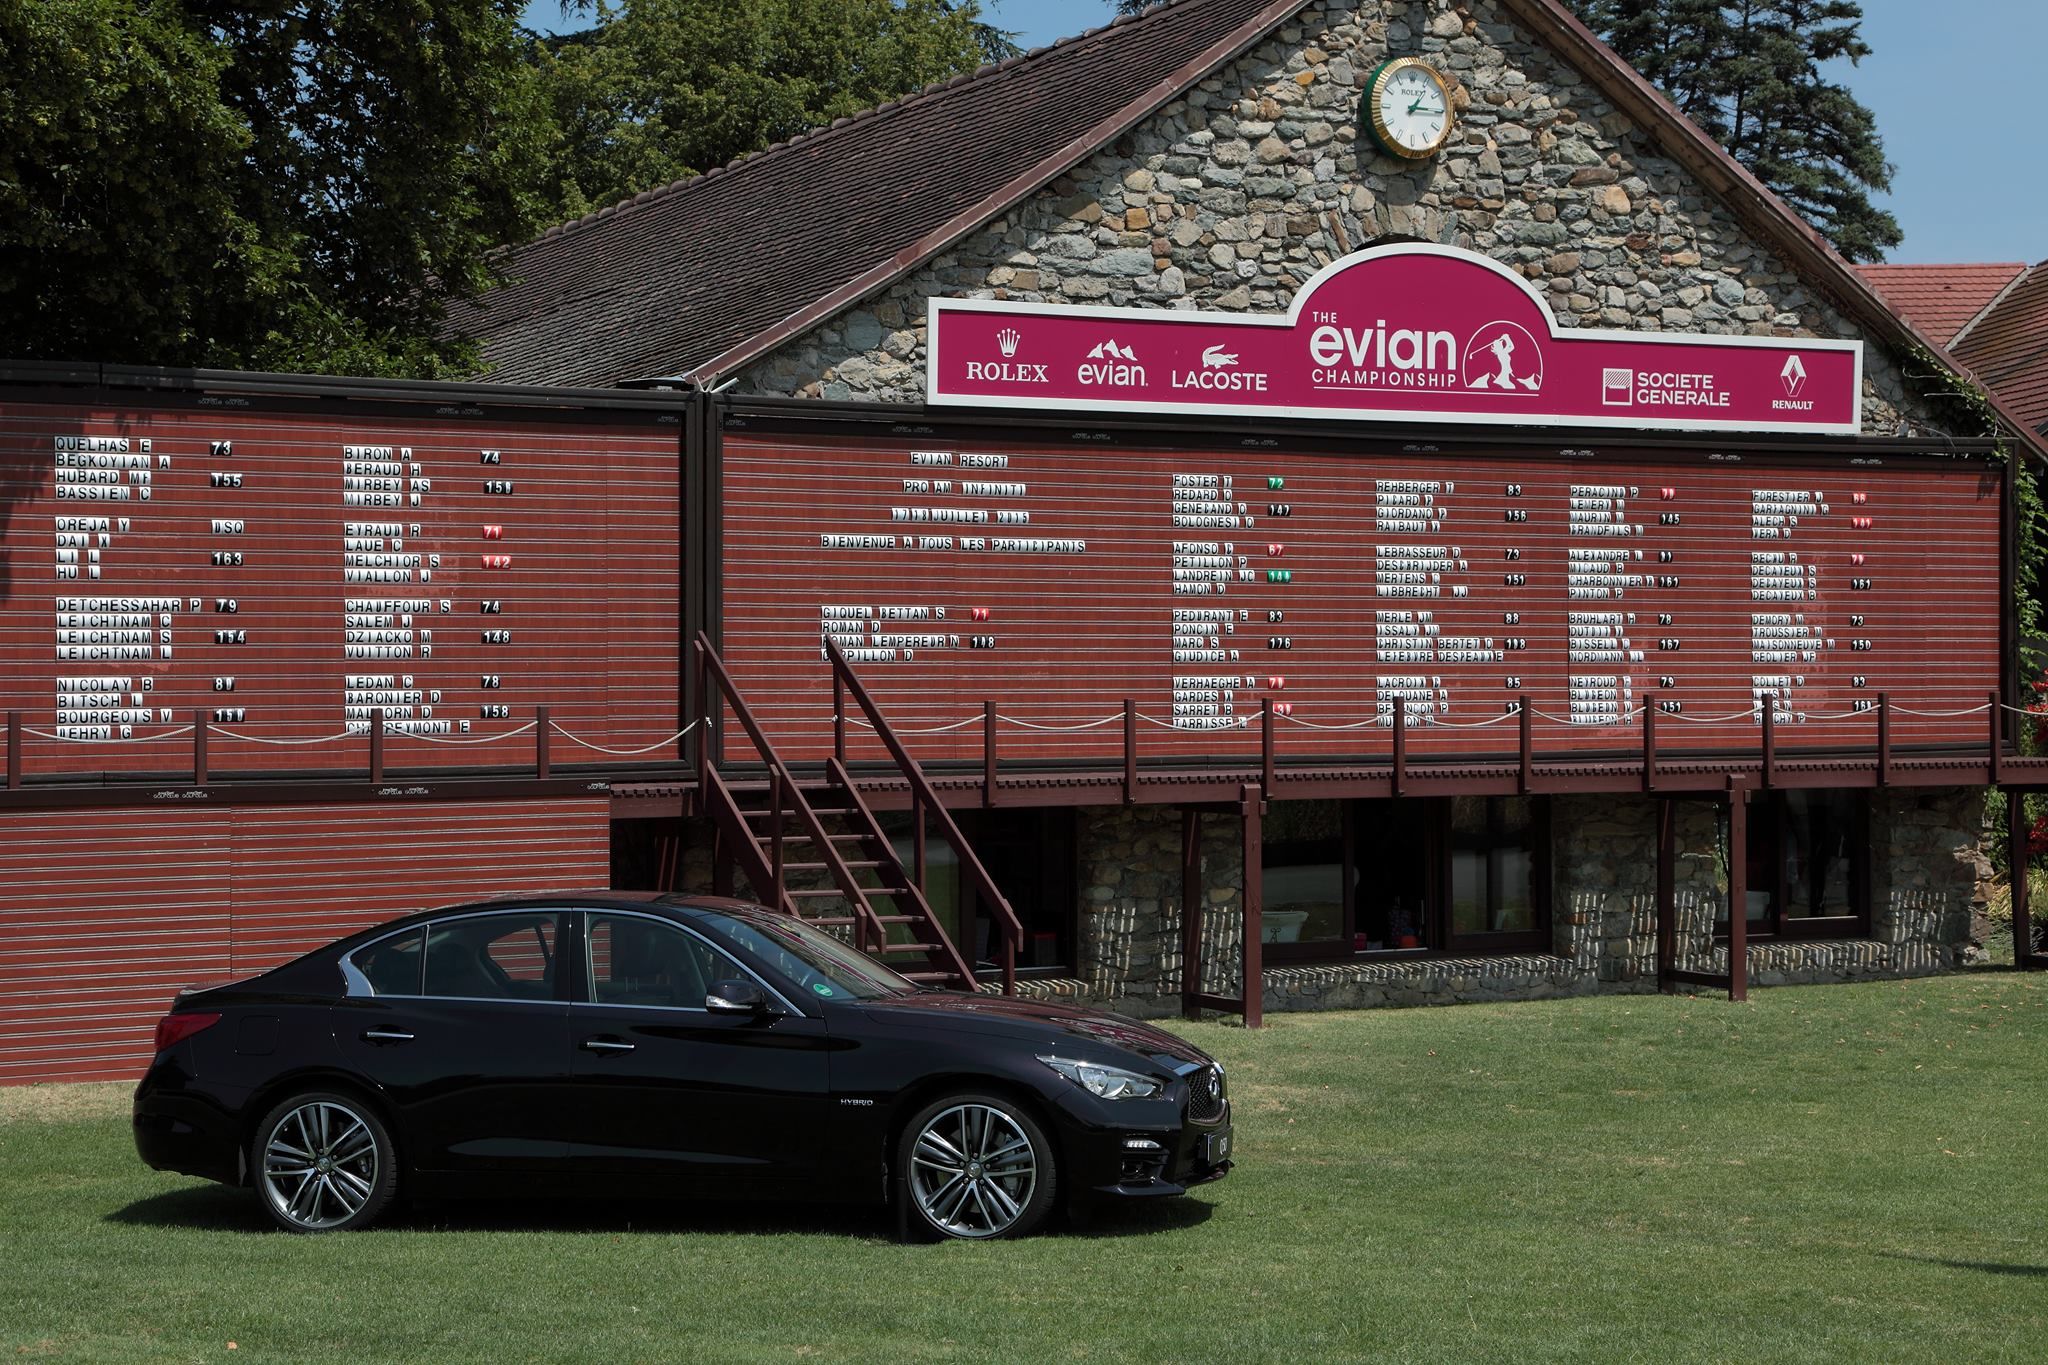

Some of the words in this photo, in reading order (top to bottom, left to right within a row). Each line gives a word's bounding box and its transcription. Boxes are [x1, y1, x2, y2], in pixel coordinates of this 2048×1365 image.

[1312, 311, 1337, 323] THE
[1310, 319, 1457, 370] evian
[966, 361, 1049, 383] ROLEX
[1078, 360, 1146, 387] evian
[1312, 368, 1456, 387] CHAMPIONSHIP
[1172, 370, 1268, 391] LACOSTE
[1637, 372, 1714, 389] SOCIETE
[1637, 389, 1730, 407] GENERALE
[1772, 400, 1814, 410] RENAULT
[56, 437, 128, 451] QUELHAS
[212, 441, 231, 455] 73
[56, 454, 149, 468] BEGKOYIAN
[345, 447, 392, 459] BIRON
[482, 451, 500, 464] 74
[911, 454, 951, 465] EVIAN
[961, 456, 1007, 467] RESORT
[346, 463, 400, 475] BERAUD
[56, 470, 118, 483] HUBARD
[1174, 476, 1218, 487] FOSTER
[1269, 478, 1283, 488] 72
[345, 479, 400, 491] MIRBEY
[412, 480, 429, 491] AS
[904, 481, 928, 492] PRO
[935, 483, 950, 493] AM
[965, 484, 1024, 495] INFINITI
[1377, 482, 1440, 492] REHBERGER
[1508, 485, 1521, 495] 83
[57, 486, 129, 499] BASSIEN
[1174, 490, 1218, 500] REDARD
[1572, 487, 1624, 497] PERACINO
[1754, 492, 1810, 501] FORESTIER
[345, 494, 400, 506] MIRBEY
[1377, 495, 1419, 505] PICARD
[1174, 503, 1232, 513] GENECAND
[1270, 504, 1289, 515] 147
[1378, 508, 1433, 519] GIORDANO
[1507, 511, 1526, 521] 156
[894, 510, 907, 520] 17
[914, 510, 927, 520] 18
[932, 510, 987, 522] JUILLET
[999, 512, 1027, 523] 2015
[1174, 517, 1237, 527] BOLOGNESI
[1571, 512, 1610, 522] MAURIN
[1662, 514, 1680, 524] 145
[1754, 517, 1784, 526] ALECH
[57, 519, 108, 531] OREJA
[214, 521, 243, 534] DSQ
[346, 525, 400, 536] EYRAUD
[485, 526, 500, 538] 71
[1377, 521, 1425, 532] RAIBAUT
[57, 535, 85, 546] DAI
[346, 540, 382, 551] LAUE
[822, 536, 895, 548] BIENVENUE
[904, 538, 911, 549] A
[920, 538, 952, 549] TOUS
[961, 538, 984, 550] LES
[993, 541, 1084, 552] PARTICIPANTS
[1174, 544, 1217, 554] AFONSO
[1269, 544, 1282, 555] 67
[1377, 548, 1446, 558] LEBRASSEUR
[1506, 549, 1520, 559] 73
[57, 550, 74, 562] LI
[214, 552, 242, 564] 163
[1570, 551, 1628, 560] ALEXANDRE
[346, 555, 420, 567] MELCHIOR
[484, 556, 510, 568] 142
[1174, 558, 1232, 567] PETILLON
[57, 567, 77, 578] HU
[1570, 564, 1610, 573] MICAUD
[347, 570, 411, 582] VIALLON
[1174, 571, 1232, 580] LANDREIN
[1377, 574, 1425, 584] MERTENS
[1507, 575, 1525, 585] 151
[1570, 577, 1641, 586] CHARBONNIER
[1661, 577, 1678, 586] 161
[1854, 580, 1870, 589] 161
[1175, 584, 1211, 594] HAMON
[1377, 587, 1438, 597] LIBBRECHT
[1570, 590, 1608, 599] PINTON
[57, 599, 180, 611] DETCHESSAHAR
[218, 600, 236, 612] 79
[346, 600, 430, 613] CHAUFFOUR
[482, 601, 500, 613] 74
[823, 607, 871, 618] GIQUEL
[881, 608, 928, 619] BETTAN
[974, 609, 987, 620] 71
[1174, 611, 1232, 621] PEDURANT
[1270, 611, 1282, 621] 83
[1377, 613, 1411, 623] MERLE
[1420, 613, 1432, 623] JM
[1506, 613, 1519, 623] 88
[1570, 614, 1622, 623] BRUHLART
[1660, 614, 1672, 624] 78
[58, 615, 150, 627] LEICHTNAM
[346, 616, 392, 628] SALEM
[1753, 616, 1790, 625] DEMORY
[1852, 616, 1864, 625] 73
[822, 621, 863, 632] ROMAN
[1174, 625, 1218, 634] PONCIN
[1379, 626, 1418, 636] ISSALY
[58, 631, 150, 643] LEICHTNAM
[218, 632, 245, 644] 154
[347, 632, 412, 643] DZIACKO
[484, 632, 510, 643] 148
[1754, 628, 1808, 637] TROUSSIER
[873, 636, 944, 647] LEMPEREUR
[1174, 638, 1203, 648] MARC
[1270, 638, 1290, 648] 176
[1378, 639, 1432, 649] CHRISTIN
[1439, 639, 1479, 649] BERTET
[1571, 640, 1616, 649] BISSELL
[1661, 640, 1679, 649] 167
[1754, 640, 1822, 649] MAISONNEUVE
[1853, 640, 1870, 650] 150
[58, 647, 150, 659] LEICHTNAM
[347, 647, 411, 658] VUITTON
[1175, 651, 1224, 662] GIUDICE
[1378, 652, 1433, 662] LEFEBVRE
[1571, 652, 1623, 662] NORDMANN
[1754, 653, 1796, 662] GEOLIER
[58, 679, 130, 691] NICOLAY
[216, 678, 232, 690] 80
[347, 678, 393, 689] LEDAN
[482, 676, 500, 688] 78
[1175, 678, 1240, 688] VERHAEGHE
[1378, 678, 1424, 688] LACROIX
[1507, 678, 1520, 688] 85
[1571, 678, 1616, 687] NEYROUD
[1661, 677, 1674, 687] 79
[1754, 677, 1790, 686] COLLET
[1853, 677, 1865, 686] 83
[58, 695, 120, 707] BITSCH
[347, 692, 421, 704] BARONIER
[1175, 692, 1218, 702] GARDES
[483, 706, 509, 718] 158
[1174, 705, 1216, 715] SARRET
[58, 711, 151, 723] BOURGEOIS
[217, 709, 243, 721] 150
